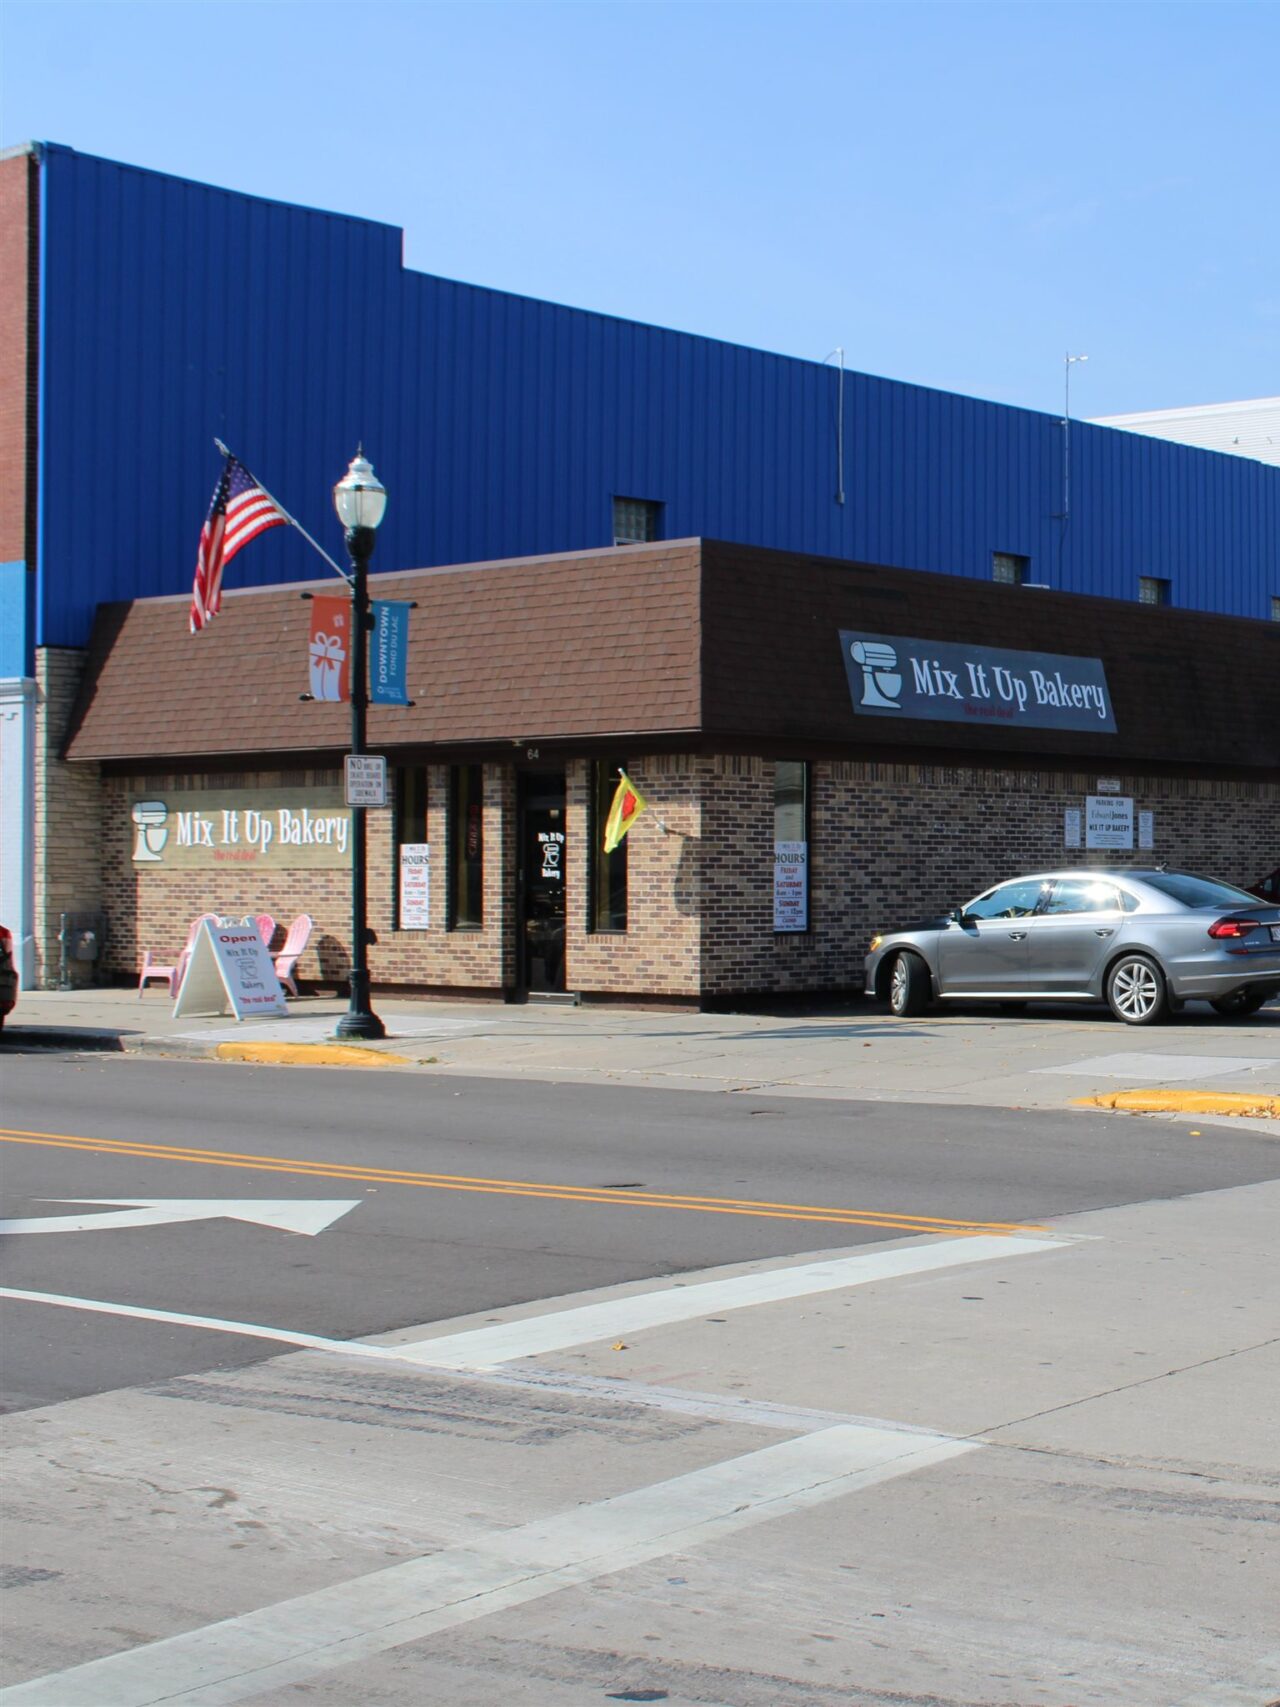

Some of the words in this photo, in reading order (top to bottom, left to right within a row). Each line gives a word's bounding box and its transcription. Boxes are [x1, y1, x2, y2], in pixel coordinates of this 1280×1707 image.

[391, 616, 399, 633] LAC
[379, 606, 390, 683] DOWNTOWN
[390, 634, 398, 648] DU
[909, 657, 964, 700] Mix
[964, 661, 991, 698] It
[991, 666, 1028, 712] Up
[1030, 670, 1107, 719] Bakery
[527, 749, 540, 760] 64
[350, 759, 361, 770] NO
[1095, 799, 1114, 807] PARKING
[176, 811, 215, 847] Mix
[221, 809, 239, 844] It
[244, 810, 273, 853] Up
[278, 808, 349, 853] Bakery
[401, 855, 429, 865] HOURS
[774, 853, 805, 864] HOURS
[219, 935, 257, 944] Open
